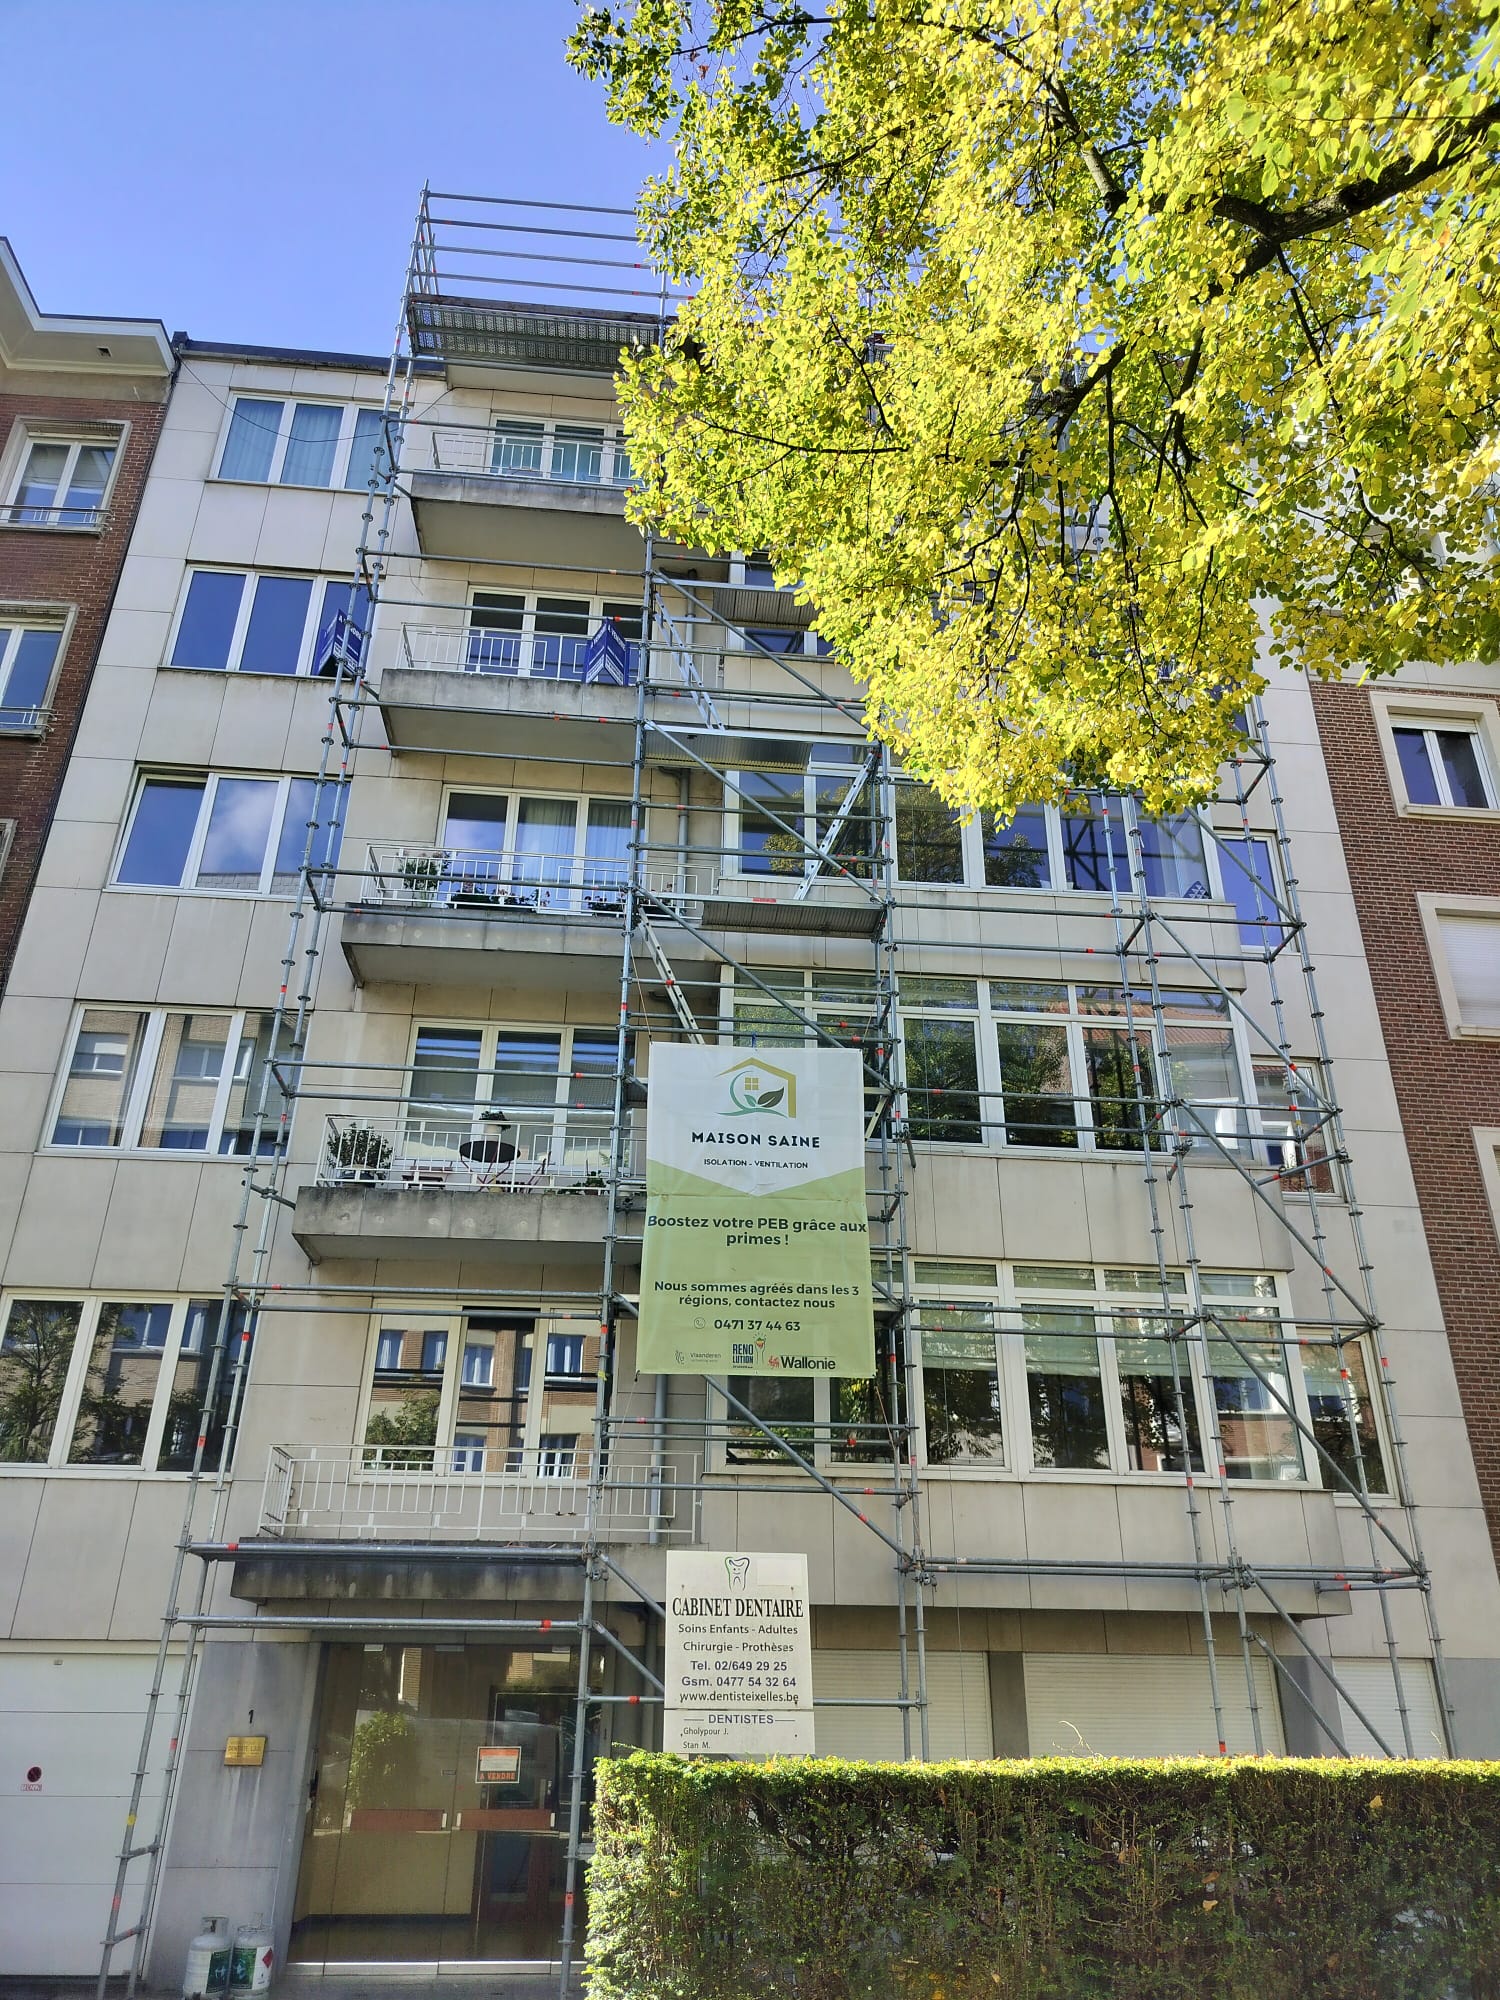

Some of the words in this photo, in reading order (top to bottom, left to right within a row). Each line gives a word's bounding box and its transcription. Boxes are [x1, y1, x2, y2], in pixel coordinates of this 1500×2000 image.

[692, 1131, 761, 1145] MAISON
[768, 1135, 820, 1148] SAINE
[704, 1158, 747, 1166] ISOLATION
[754, 1160, 808, 1169] VENTILATION
[647, 1215, 709, 1227] Boostez
[713, 1217, 754, 1229] votre
[757, 1218, 788, 1230] PEB
[793, 1219, 836, 1233] grâce
[840, 1221, 867, 1233] aux
[726, 1231, 781, 1247] primes
[654, 1281, 688, 1291] Nous
[690, 1283, 747, 1293] sommes
[749, 1282, 793, 1297] agréés
[796, 1284, 829, 1295] dans
[831, 1284, 850, 1295] les
[852, 1286, 860, 1296] 3
[679, 1294, 732, 1307] régions,
[734, 1298, 800, 1308] contactez
[803, 1300, 835, 1309] nous
[714, 1319, 744, 1330] 0471
[747, 1320, 762, 1331] 37
[766, 1321, 782, 1331] 44
[785, 1321, 801, 1332] 63
[732, 1344, 754, 1355] RENO
[732, 1355, 754, 1364] LUTION
[781, 1356, 836, 1370] Wallonie
[672, 1597, 732, 1617] CABINET
[735, 1598, 804, 1618] DENTAIRE
[678, 1624, 707, 1634] Soins
[709, 1624, 749, 1634] Enfants
[758, 1625, 798, 1635] Adultes
[683, 1641, 733, 1653] Chirurgie
[742, 1642, 794, 1652] Prothèses
[690, 1660, 711, 1671] Tel.
[714, 1660, 753, 1671] 02/649
[756, 1661, 770, 1671] 29
[774, 1661, 788, 1671] 25
[681, 1676, 713, 1687] Gsm.
[716, 1676, 745, 1687] 0477
[748, 1677, 762, 1687] 54
[765, 1677, 779, 1687] 32
[782, 1677, 796, 1687] 64
[679, 1690, 799, 1703] www.dentisteixelles.be
[248, 1709, 255, 1724] 1
[708, 1714, 774, 1724] DENTISTES
[683, 1727, 721, 1737] Gholypour
[683, 1741, 699, 1749] Stan
[702, 1741, 711, 1749] M.
[479, 1772, 485, 1780] A
[487, 1772, 516, 1780] VENDRE
